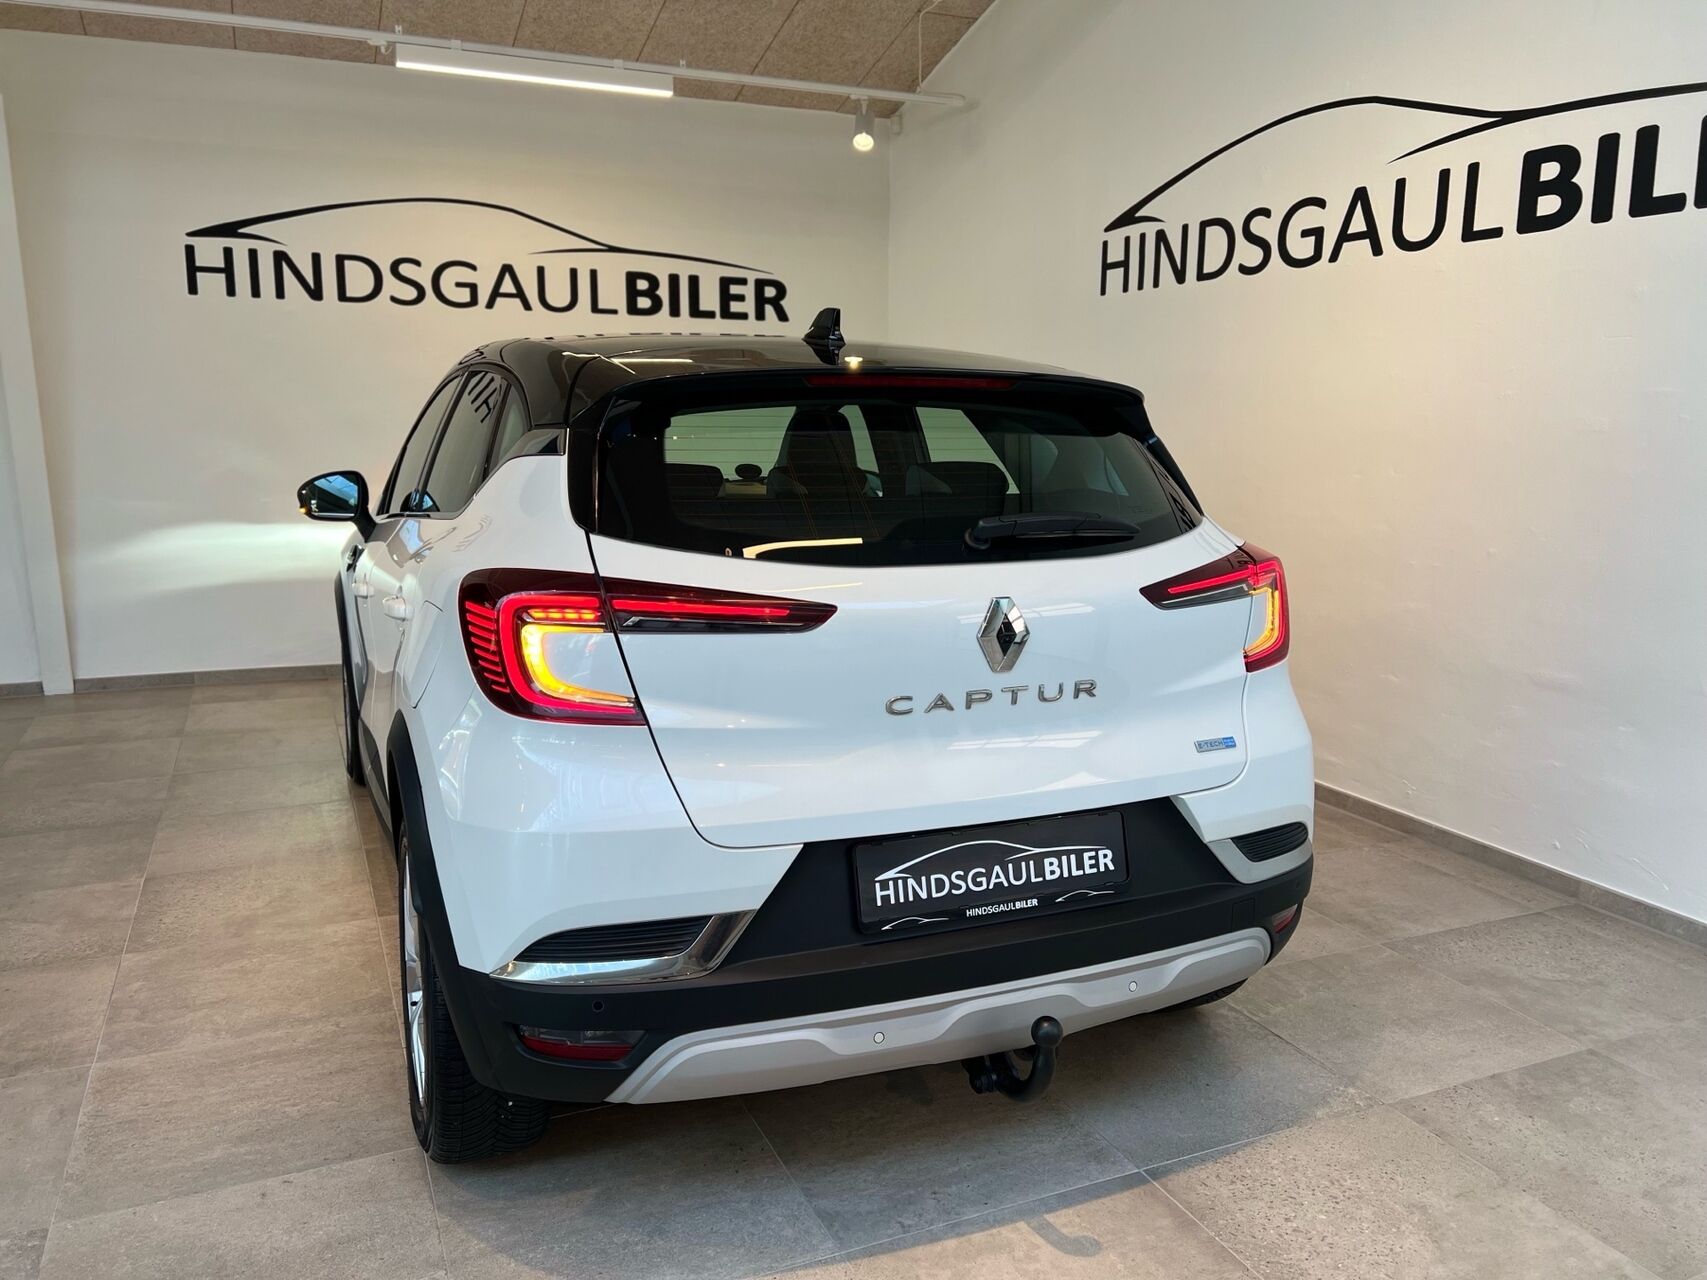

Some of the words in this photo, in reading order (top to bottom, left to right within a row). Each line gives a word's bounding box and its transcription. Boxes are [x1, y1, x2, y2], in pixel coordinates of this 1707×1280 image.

[1100, 115, 1707, 297] HINDSGAULBIL
[184, 243, 790, 323] HINDSGAULBILER
[885, 678, 1098, 716] CAPTUR
[874, 848, 1115, 907] HINDSGAULBILER
[966, 898, 1039, 918] HINDSGAULBILER
